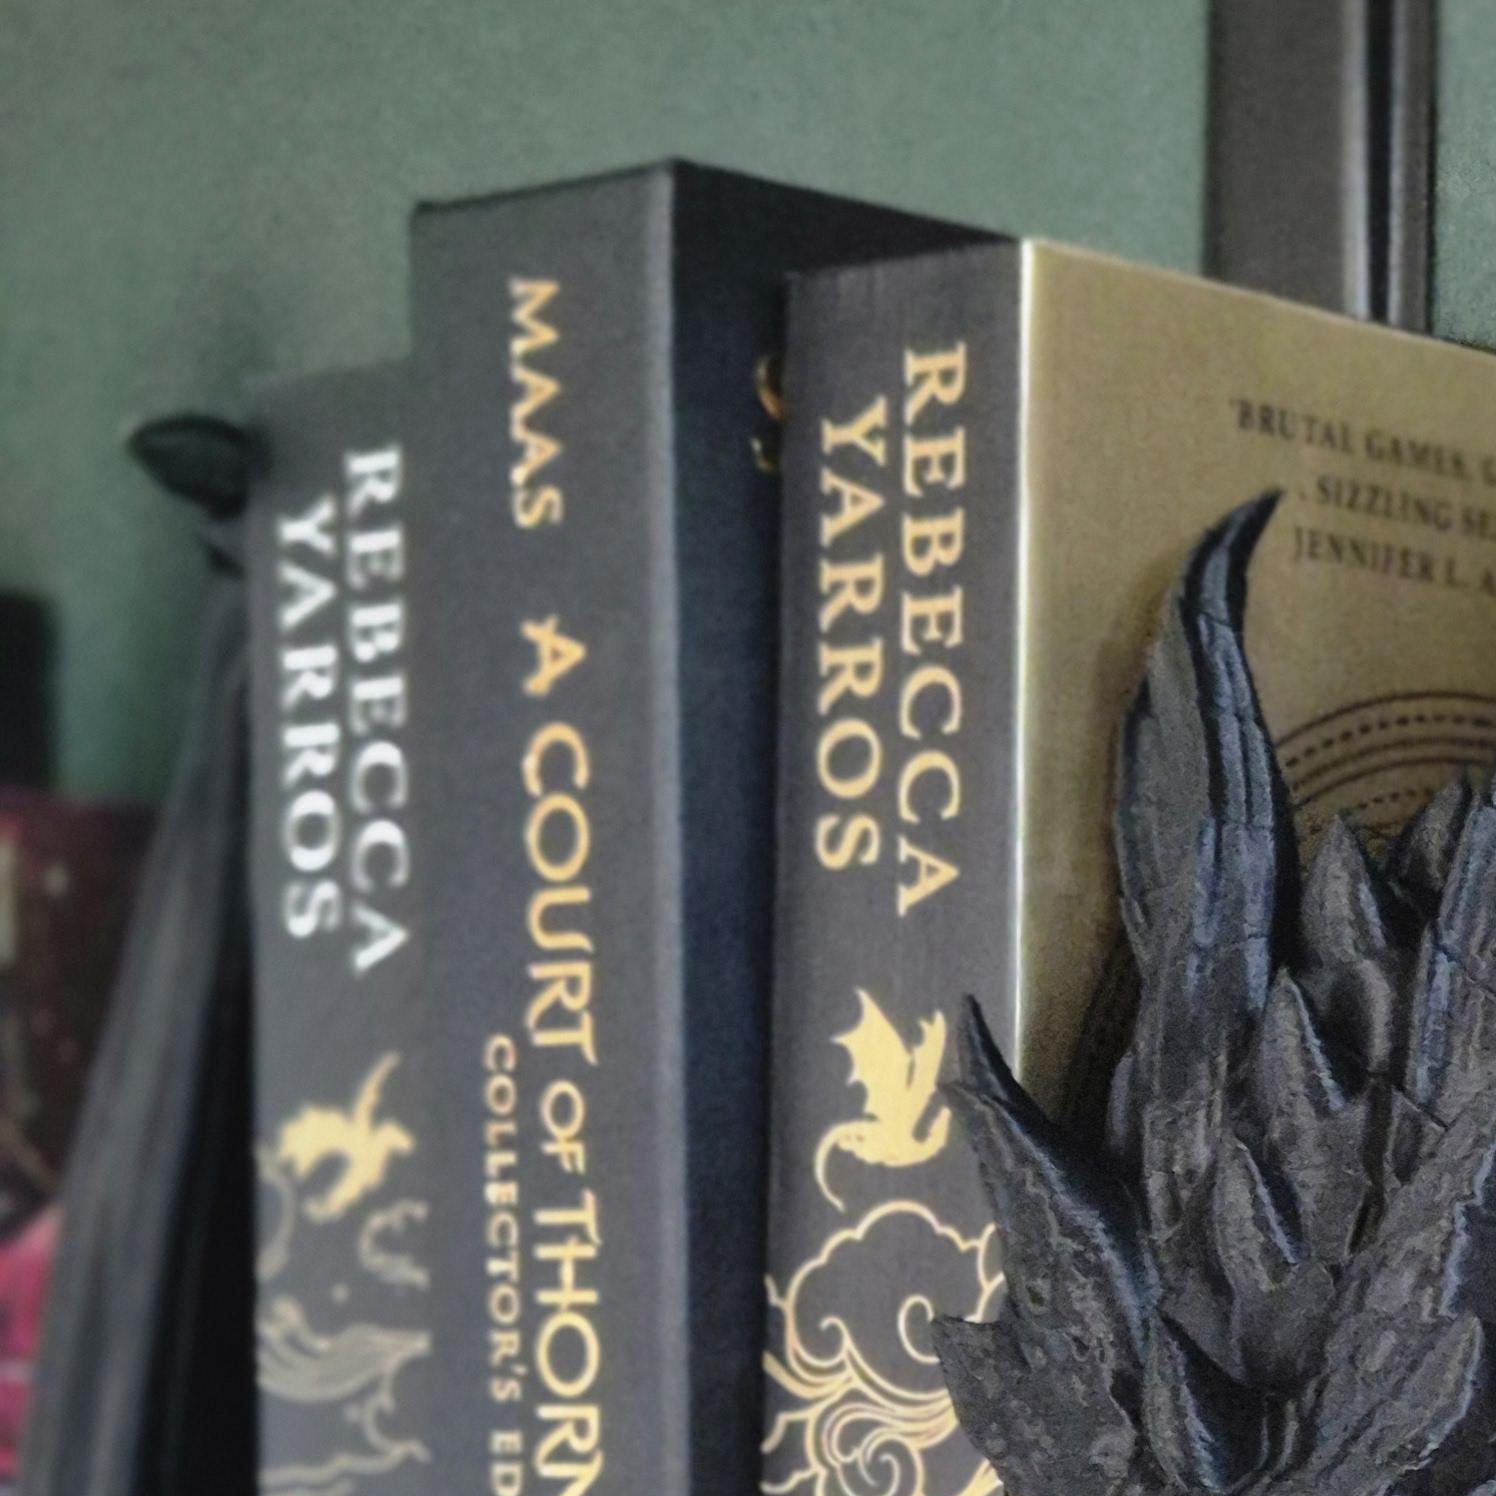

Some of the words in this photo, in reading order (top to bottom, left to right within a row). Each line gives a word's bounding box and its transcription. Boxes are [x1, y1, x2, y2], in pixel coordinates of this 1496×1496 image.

[509, 276, 563, 528] MAAS
[278, 493, 341, 938] YARROS
[344, 443, 408, 976] REBECCA
[521, 615, 587, 695] A
[815, 395, 887, 872] YARROS
[898, 341, 967, 917] REBECCA
[521, 721, 598, 1067] COURT
[483, 1034, 528, 1402] COLLECTOR'S
[540, 1079, 587, 1175] OF
